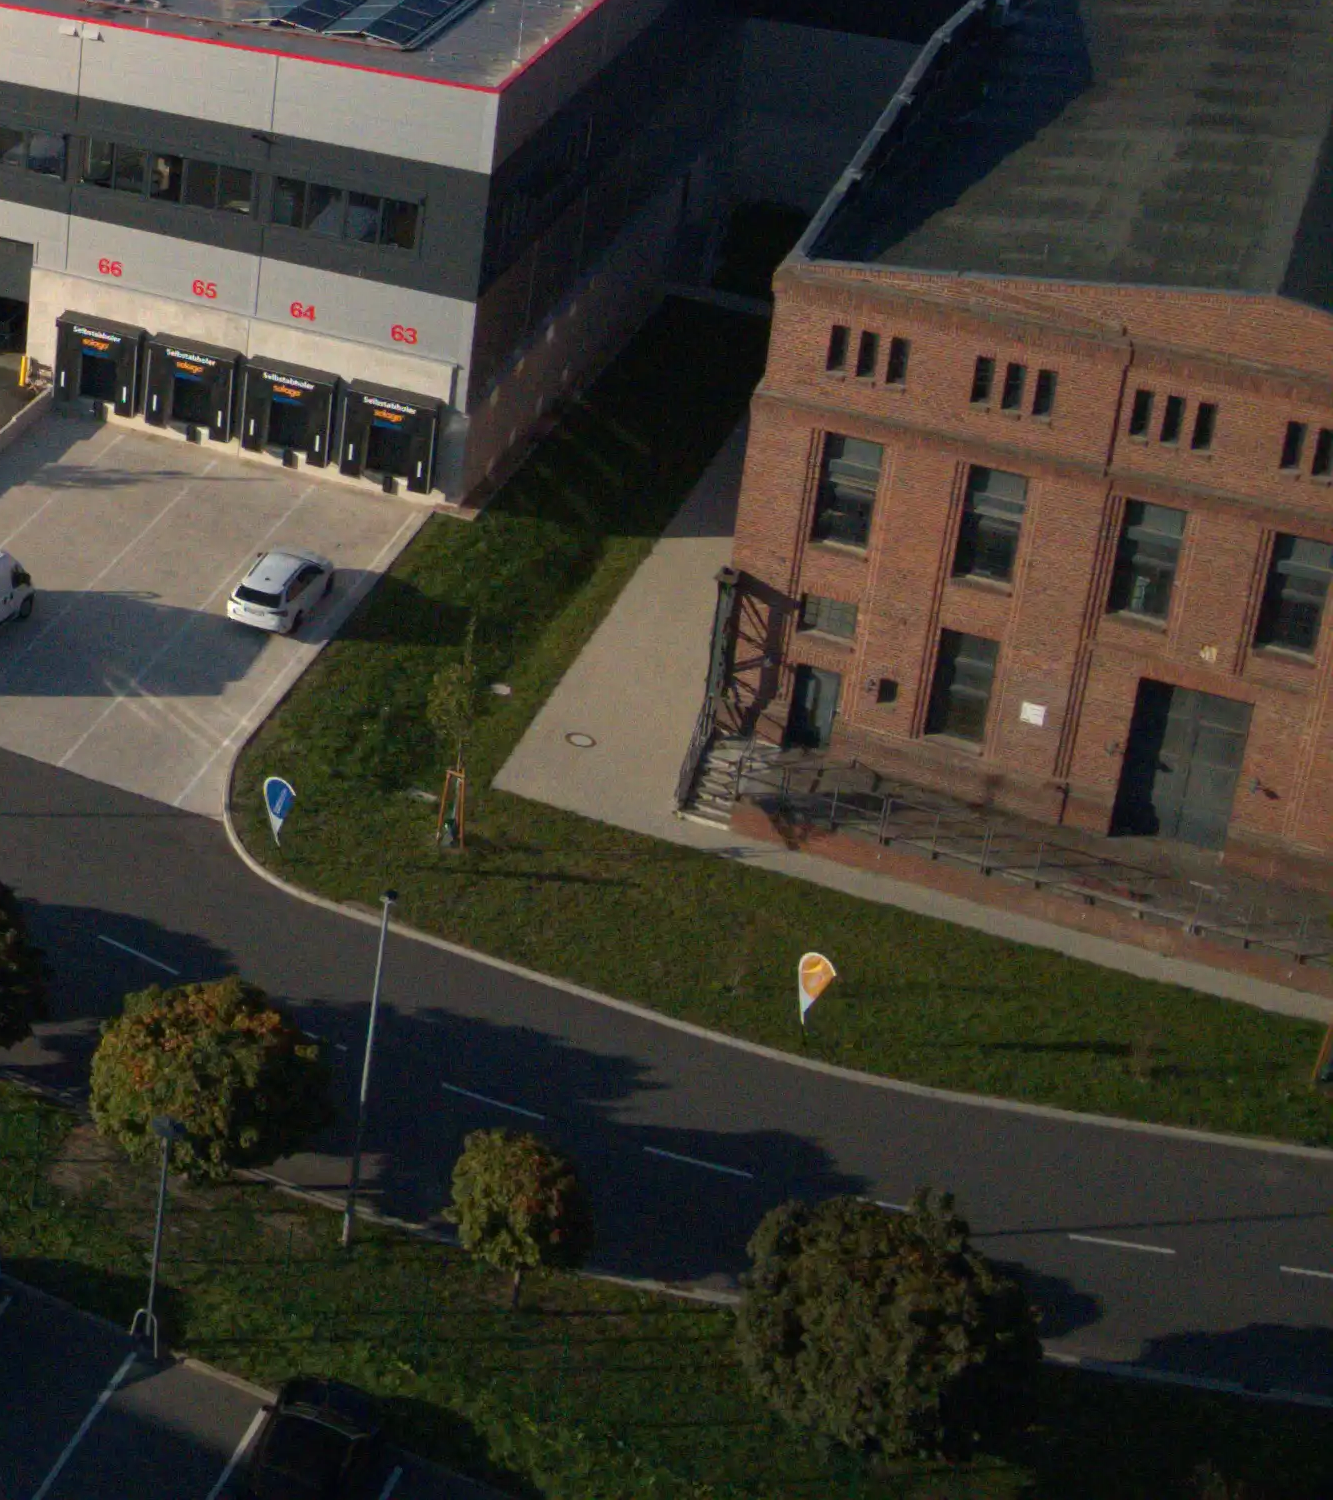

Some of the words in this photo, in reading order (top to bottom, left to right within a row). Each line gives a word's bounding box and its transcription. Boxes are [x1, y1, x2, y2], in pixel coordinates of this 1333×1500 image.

[98, 258, 123, 277] 66
[192, 279, 218, 299] 65
[290, 302, 316, 322] 64
[391, 324, 418, 345] 63
[363, 396, 418, 415] Selbstabholer
